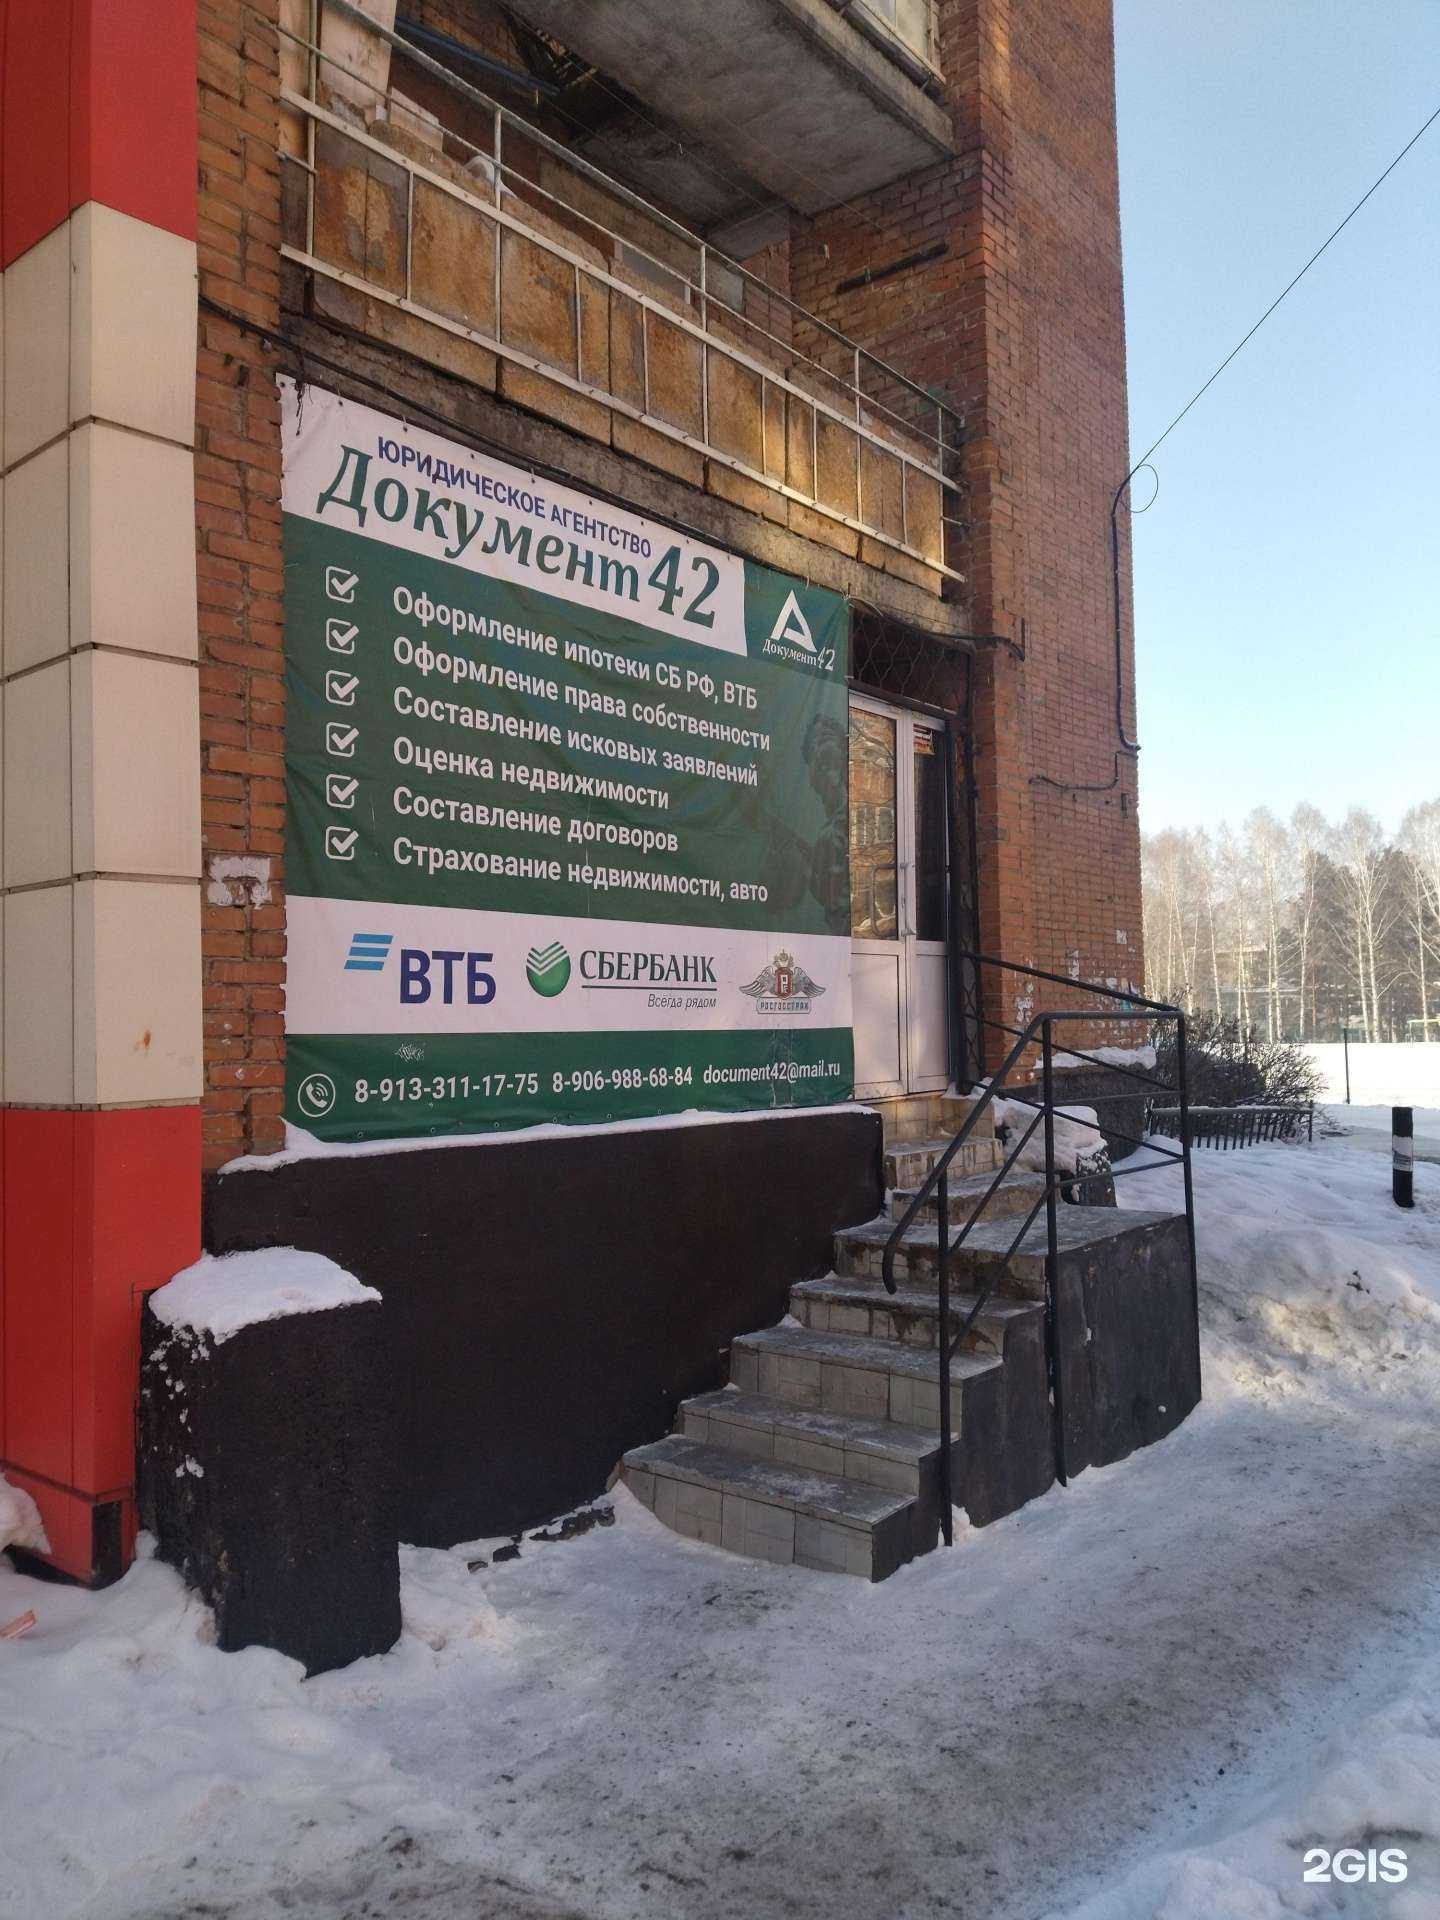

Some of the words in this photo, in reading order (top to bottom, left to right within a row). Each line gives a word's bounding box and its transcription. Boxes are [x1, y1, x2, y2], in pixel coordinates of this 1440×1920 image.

[378, 436, 546, 519] ЮРИДИЧЕСКОЕ
[551, 504, 651, 558] АГЕНТСТВО
[393, 586, 558, 655] Оформление
[565, 640, 650, 681] ипотеки
[655, 662, 682, 690] СБ
[686, 670, 718, 705] РФ,
[723, 680, 758, 710] ВТБ
[393, 637, 558, 701] Оформление
[565, 685, 627, 719] права
[632, 702, 770, 751] собственности
[393, 687, 562, 746] Составление
[567, 729, 658, 767] исковых
[662, 751, 758, 787] заявлений
[393, 737, 494, 779] Оценка
[501, 761, 669, 810] недвижимости
[393, 787, 562, 836] Составление
[567, 817, 679, 853] договоров
[393, 837, 561, 880] Страхование
[567, 865, 725, 902] недвижимости,
[729, 881, 769, 902] авто
[400, 948, 497, 1005] ВТБ
[579, 949, 718, 984] СБЕРБАНК
[647, 993, 683, 1010] Всегда
[685, 996, 717, 1011] рядом
[354, 1072, 539, 1103] 8-913-311-17-75
[552, 1066, 693, 1093] 8-906-988-68-84
[703, 1059, 841, 1085] document42@mail.ru
